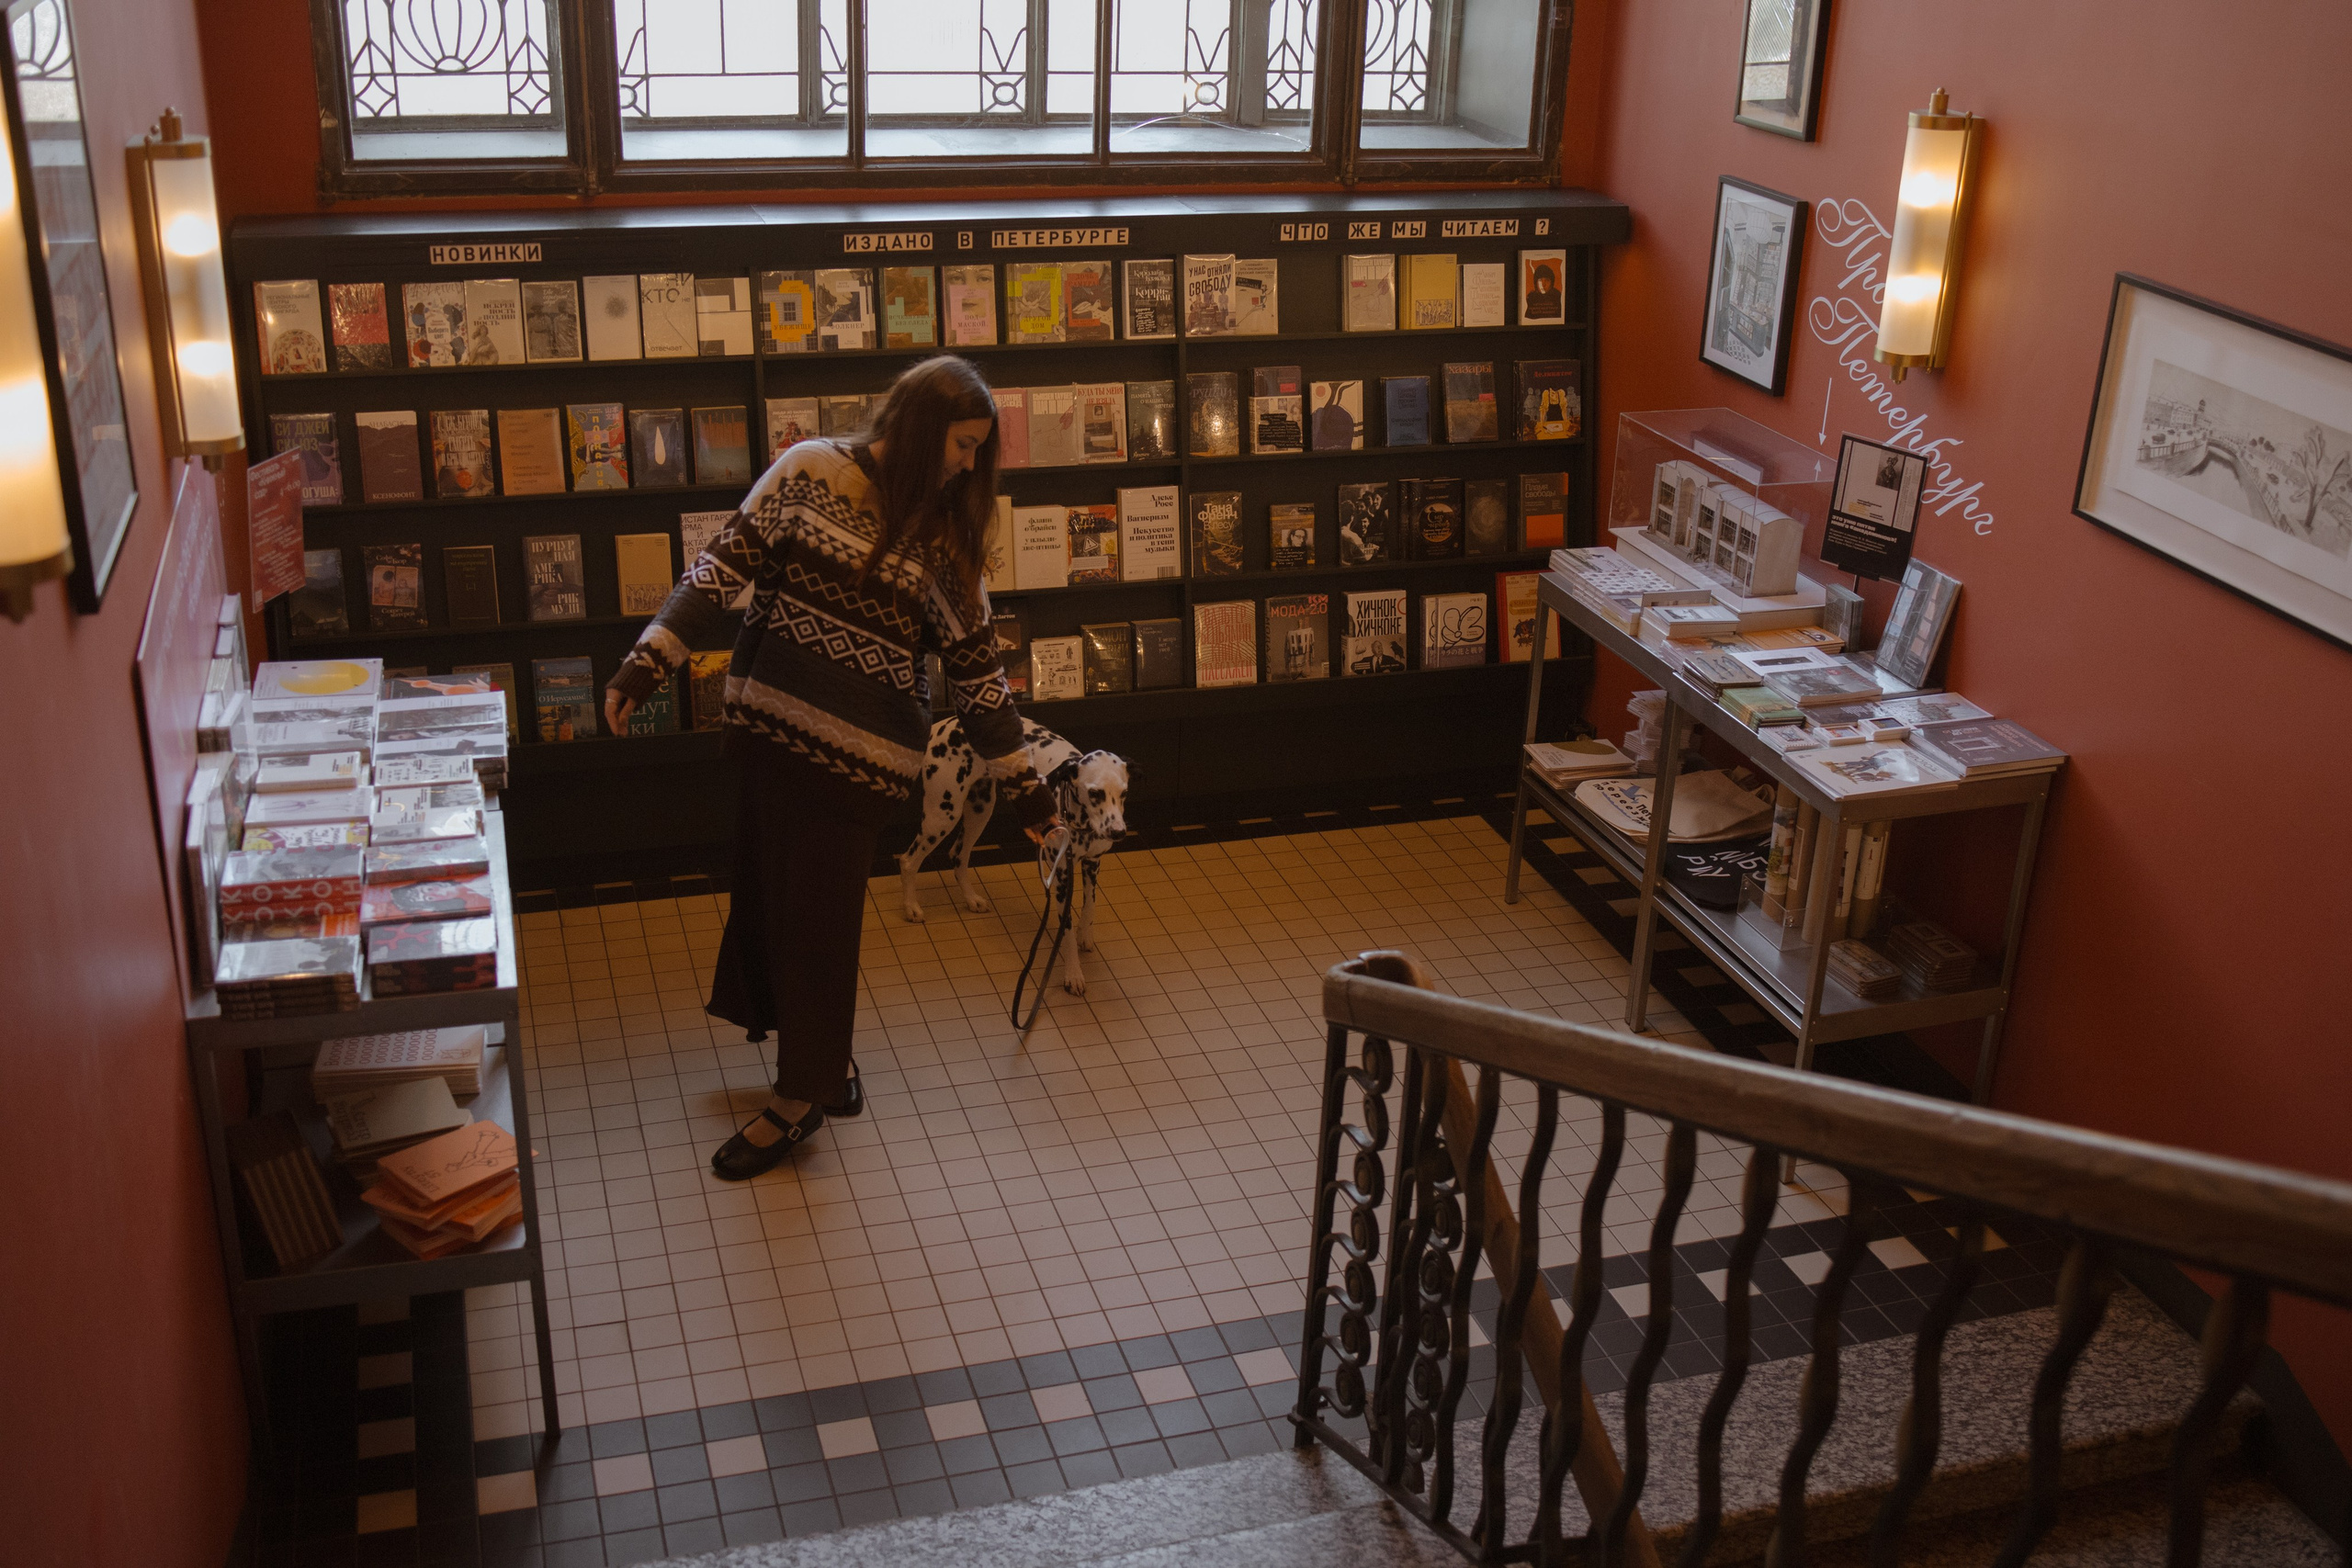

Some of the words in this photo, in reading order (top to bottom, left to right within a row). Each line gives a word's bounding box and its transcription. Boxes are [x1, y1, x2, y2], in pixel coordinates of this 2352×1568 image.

[1283, 225, 1326, 239] ЧТО
[1350, 224, 1378, 237] ЖЕ
[1395, 222, 1423, 236] МЫ
[1445, 220, 1516, 235] ЧИТАЕМ
[1539, 220, 1546, 233] ?
[846, 233, 931, 251] ИЗДАНО
[960, 233, 970, 247] В
[994, 230, 1126, 246] ПЕТЕРБУРГЕ
[433, 245, 540, 263] НОВИНКИ
[1193, 265, 1206, 276] НАС
[1207, 263, 1232, 277] ОТНЯЛИ
[1189, 275, 1232, 297] СВОБОДУ
[641, 288, 680, 304] КТО
[774, 322, 812, 332] УБЕЖИЩЕ
[830, 321, 865, 330] ФОЛКНЕР
[1448, 364, 1492, 375] хазары
[1077, 388, 1095, 398] КУДА
[1096, 388, 1105, 396] ТЫ
[1106, 386, 1124, 396] МЕНЯ
[1808, 296, 1995, 536] Петербург
[276, 423, 290, 436] СИ
[295, 419, 330, 436] ДЖЕЙ
[301, 487, 338, 499] ОГУША:
[1525, 483, 1548, 491] Пламя
[372, 491, 416, 500] КСЕНОФОНТ
[1150, 493, 1174, 502] Алекс
[1524, 491, 1556, 499] свободы
[1204, 502, 1233, 513] Тана
[1126, 514, 1170, 523] Вагнеризм
[1198, 511, 1238, 522] Френч
[1133, 527, 1175, 536] Искусство
[1210, 520, 1235, 531] лесу
[1136, 534, 1173, 542] политика
[531, 539, 575, 553] ПУРПУР
[553, 550, 576, 562] НАЯ
[534, 562, 556, 573] АМЕ
[534, 572, 563, 583] РИКА
[558, 592, 580, 604] РИК
[550, 604, 580, 615] МУДИ
[1271, 604, 1305, 618] МОДА
[1356, 598, 1396, 619] ХИЧКОК
[1204, 606, 1247, 625] ВАЛЬТЕР
[1356, 616, 1402, 637] ХИЧКОКЕ
[1201, 624, 1252, 644] БЕНЬЯМИН
[1201, 658, 1253, 681] ПАССАЖЕЙ
[631, 722, 655, 735] ки
